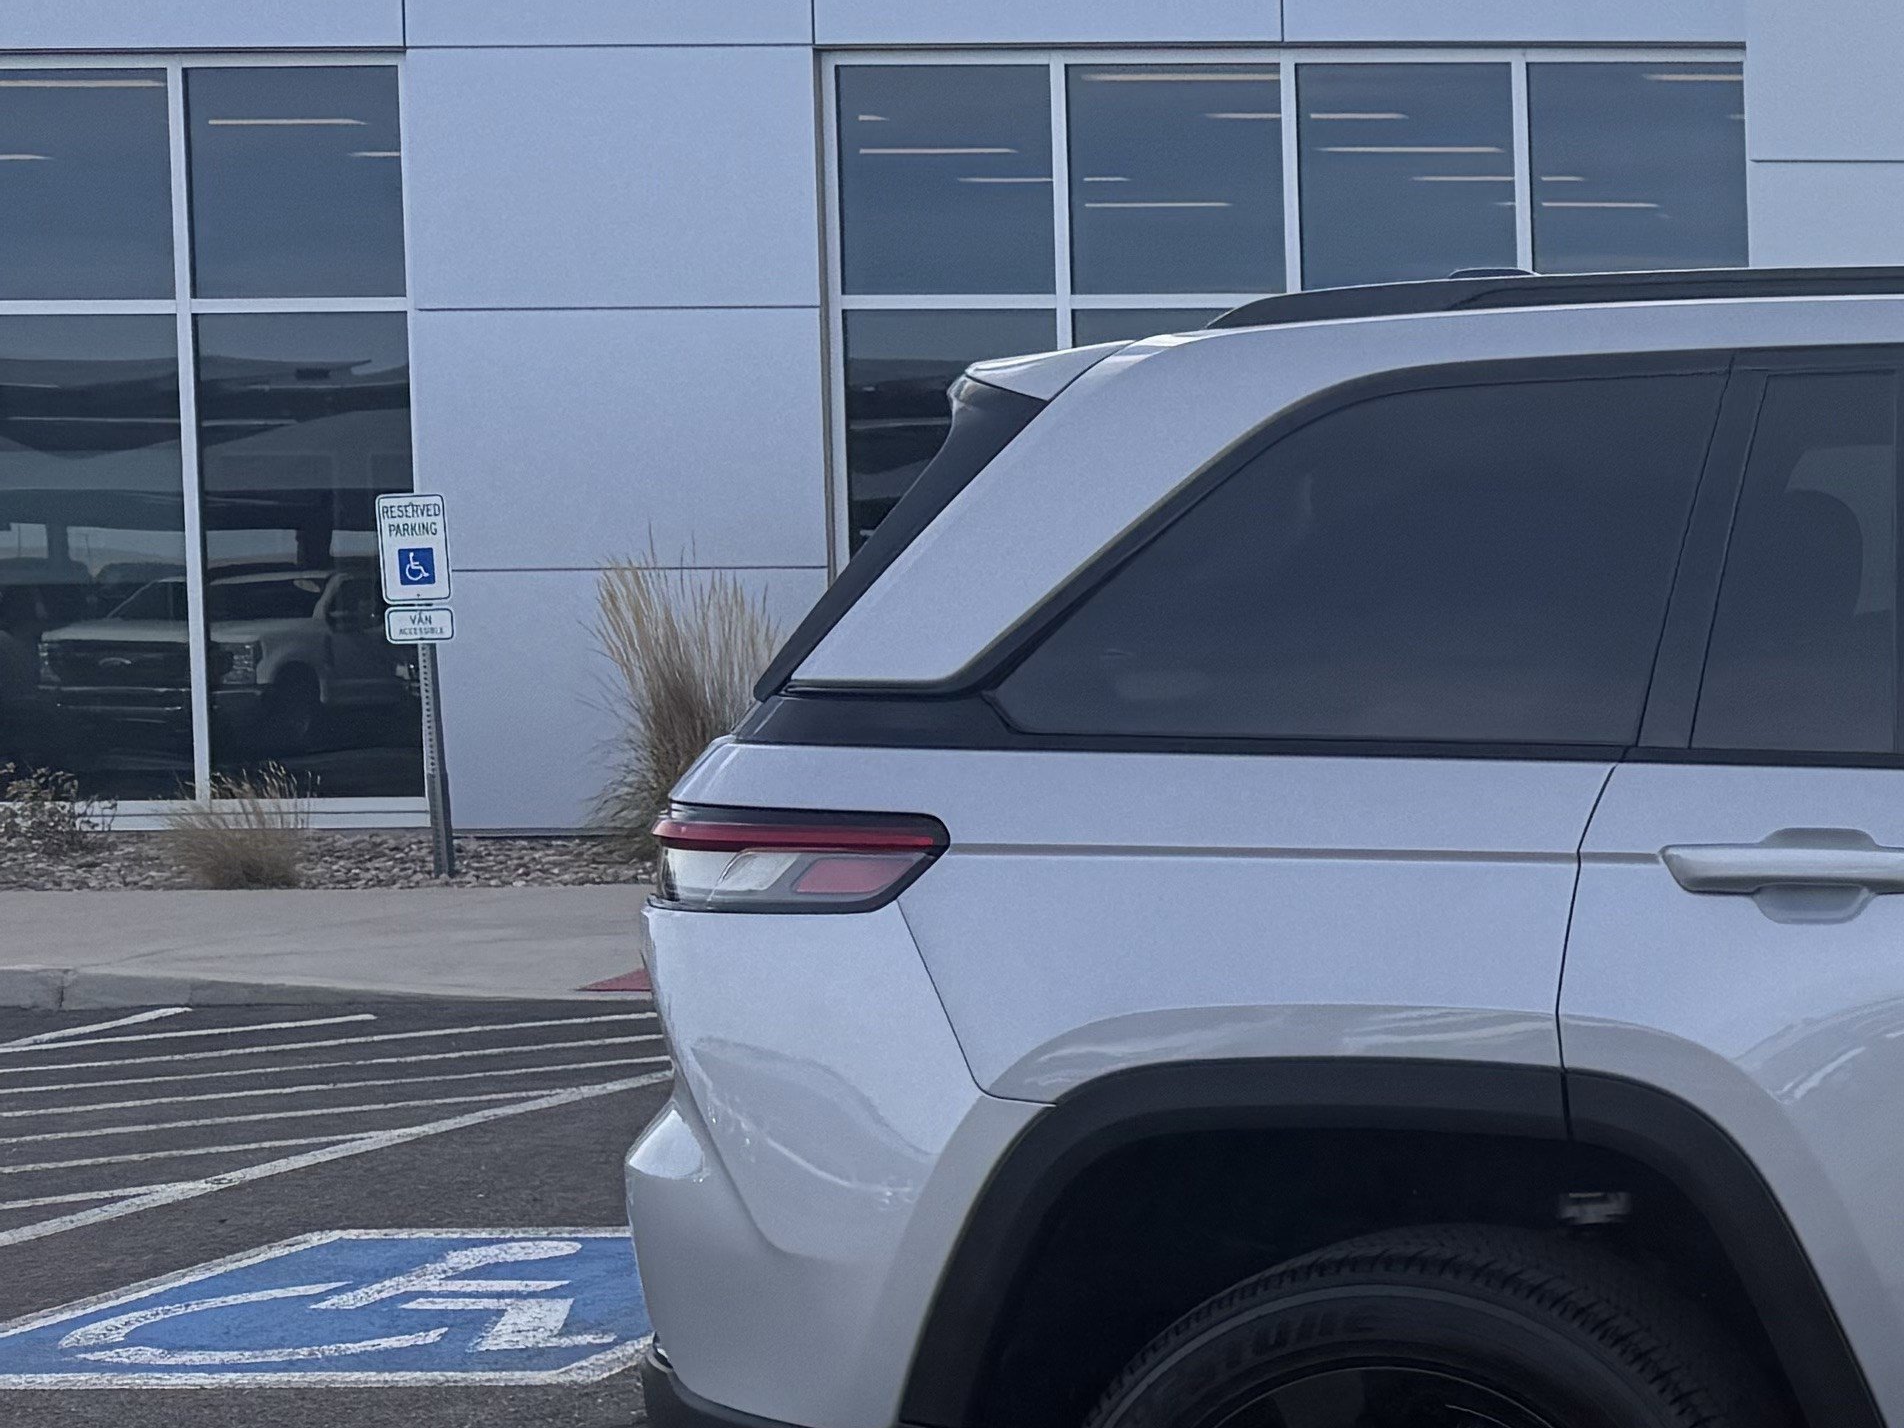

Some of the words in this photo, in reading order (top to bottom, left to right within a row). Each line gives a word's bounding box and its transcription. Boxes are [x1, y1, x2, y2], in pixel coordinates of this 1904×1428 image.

[381, 503, 441, 520] RESERVED
[388, 522, 438, 538] PARKING
[410, 614, 432, 625] VAN
